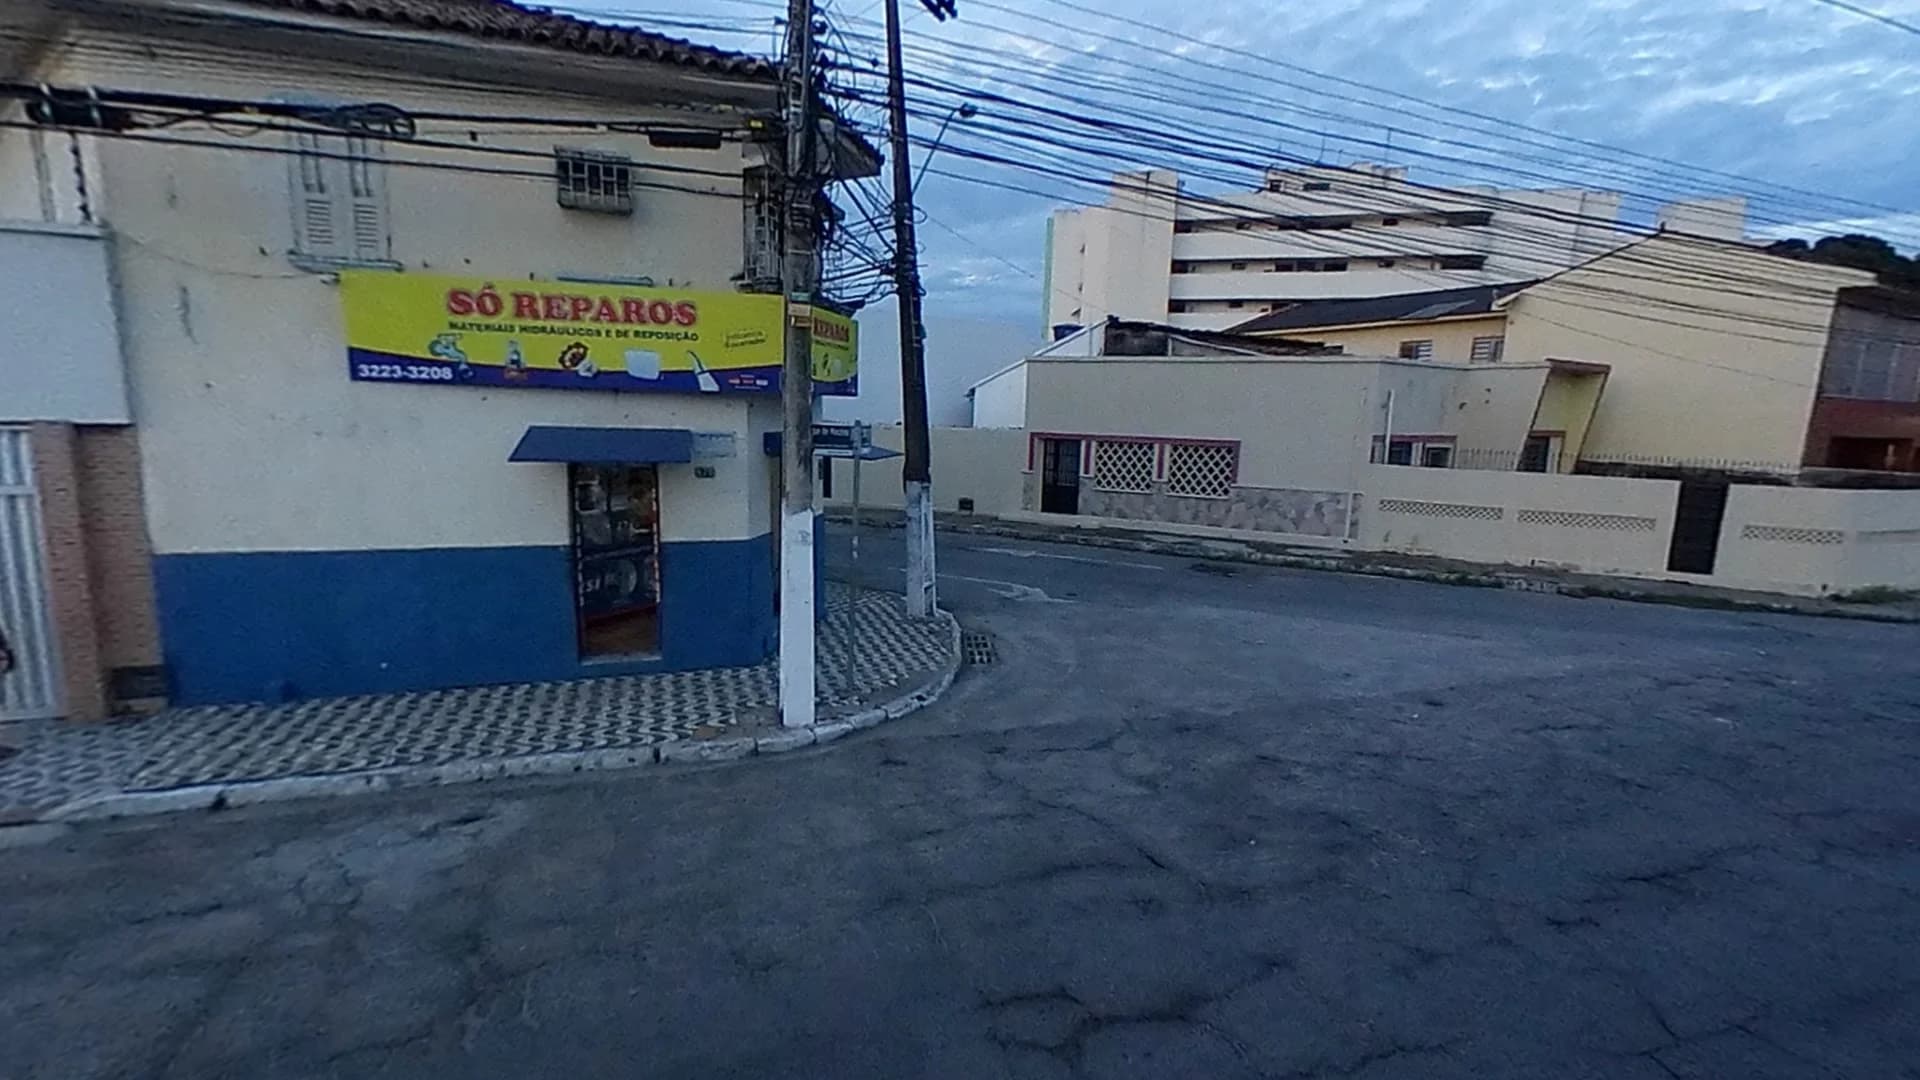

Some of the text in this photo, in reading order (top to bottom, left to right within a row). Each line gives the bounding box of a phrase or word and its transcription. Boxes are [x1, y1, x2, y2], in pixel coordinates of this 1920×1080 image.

[510, 291, 698, 327] REPAROS
[448, 321, 516, 334] MATERIAIS
[606, 329, 613, 339] E
[616, 329, 630, 339] DE
[633, 329, 700, 343] REPOSIÇÃO
[358, 364, 453, 380] 3223-3208
